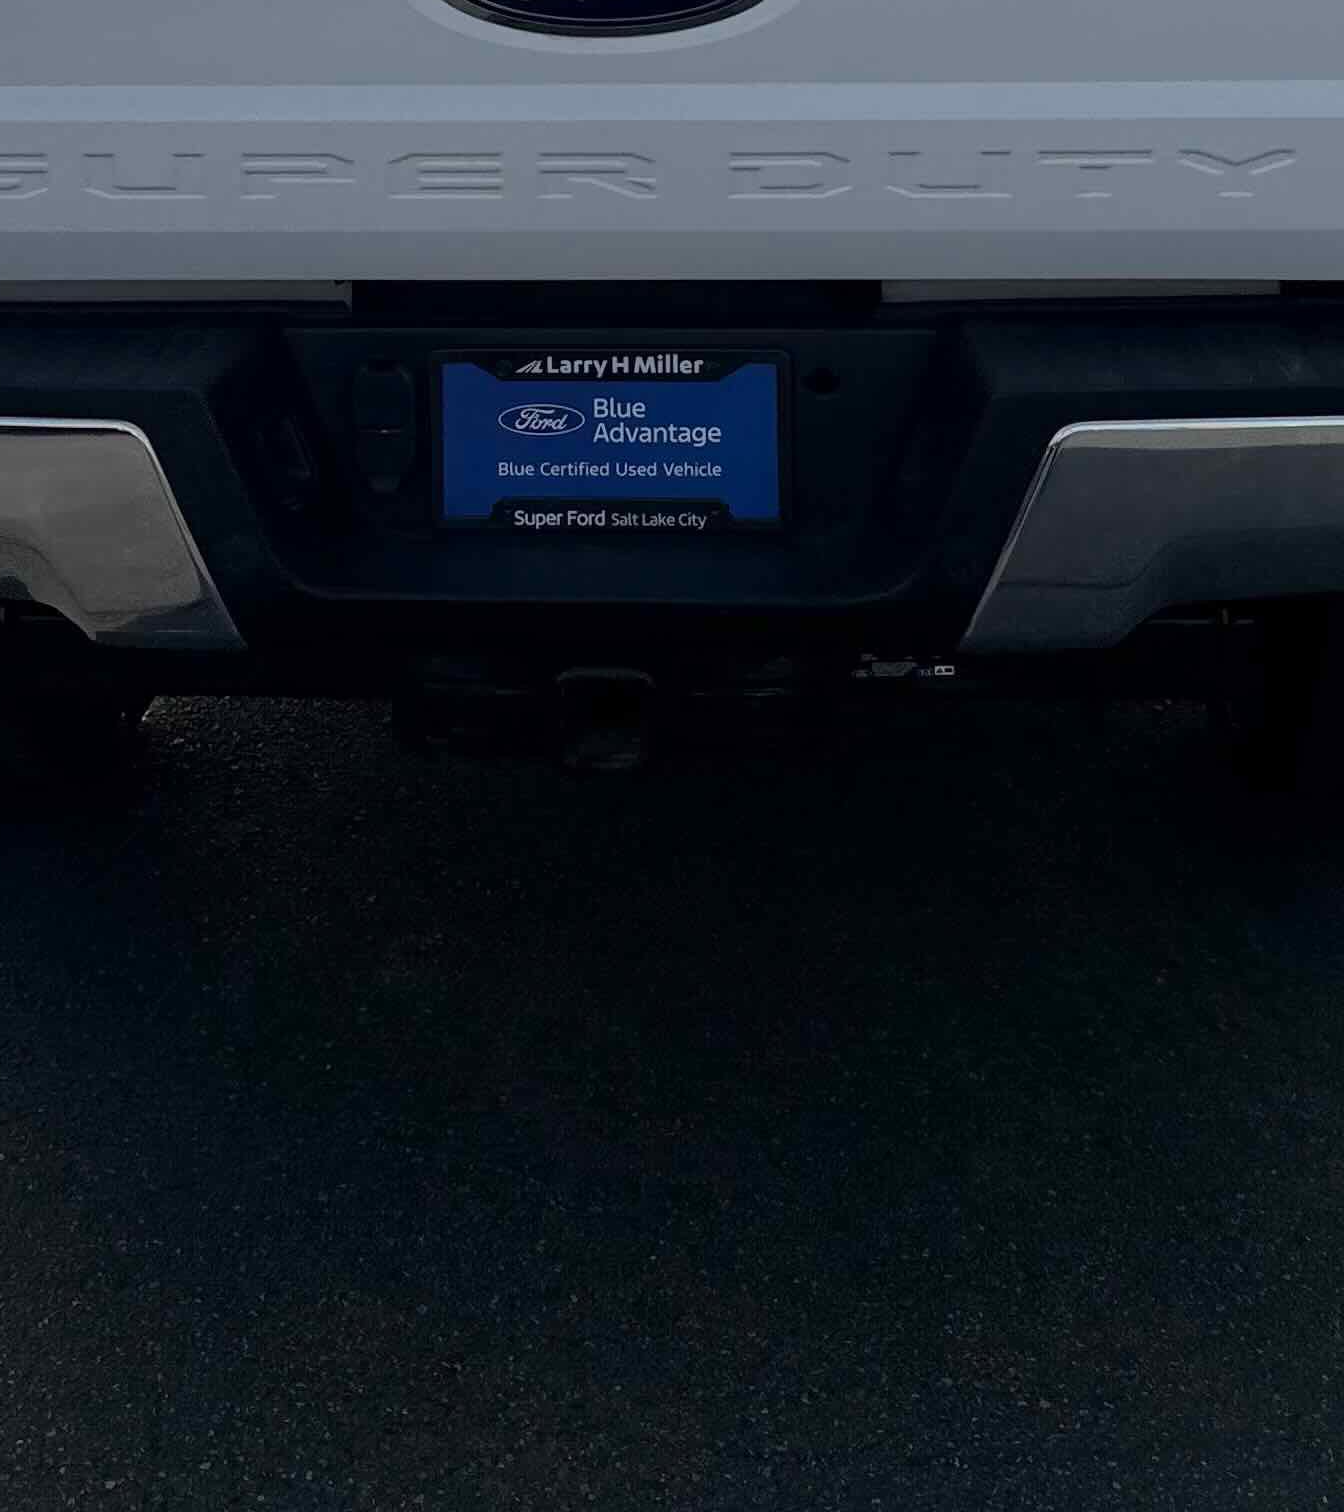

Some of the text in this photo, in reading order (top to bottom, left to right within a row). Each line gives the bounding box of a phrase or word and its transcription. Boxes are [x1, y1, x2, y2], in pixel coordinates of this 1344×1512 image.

[727, 149, 1296, 199] DUTY
[547, 354, 704, 378] Larry H Miller
[514, 408, 568, 431] Ford
[593, 397, 646, 419] Blue
[593, 422, 721, 447] Advantage
[498, 462, 722, 477] Blue Certified Used Vehicle
[514, 509, 707, 529] Super Ford Salt Lake City
